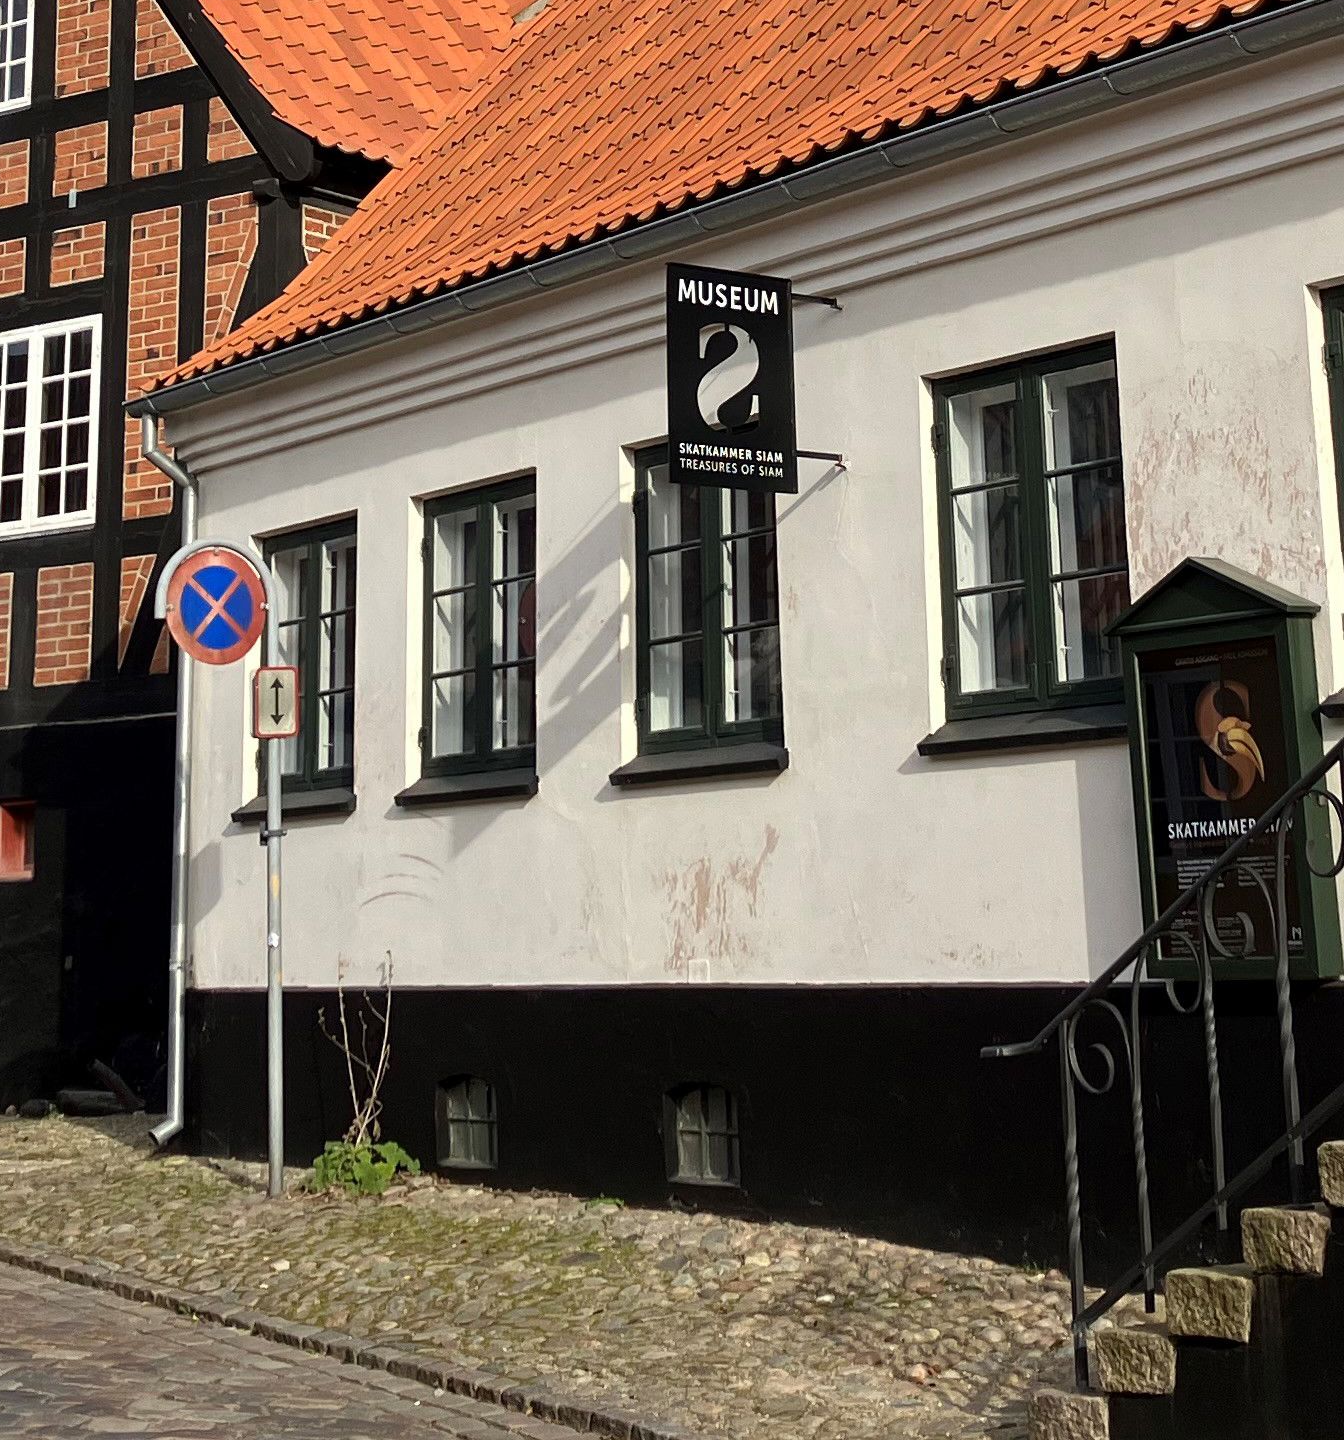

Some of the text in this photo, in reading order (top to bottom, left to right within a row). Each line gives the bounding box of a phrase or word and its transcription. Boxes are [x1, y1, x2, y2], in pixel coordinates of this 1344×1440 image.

[678, 278, 779, 315] MUSEUM
[679, 442, 783, 464] SKATKAMMER SIAM
[679, 457, 784, 478] TREASURES OF SIAM
